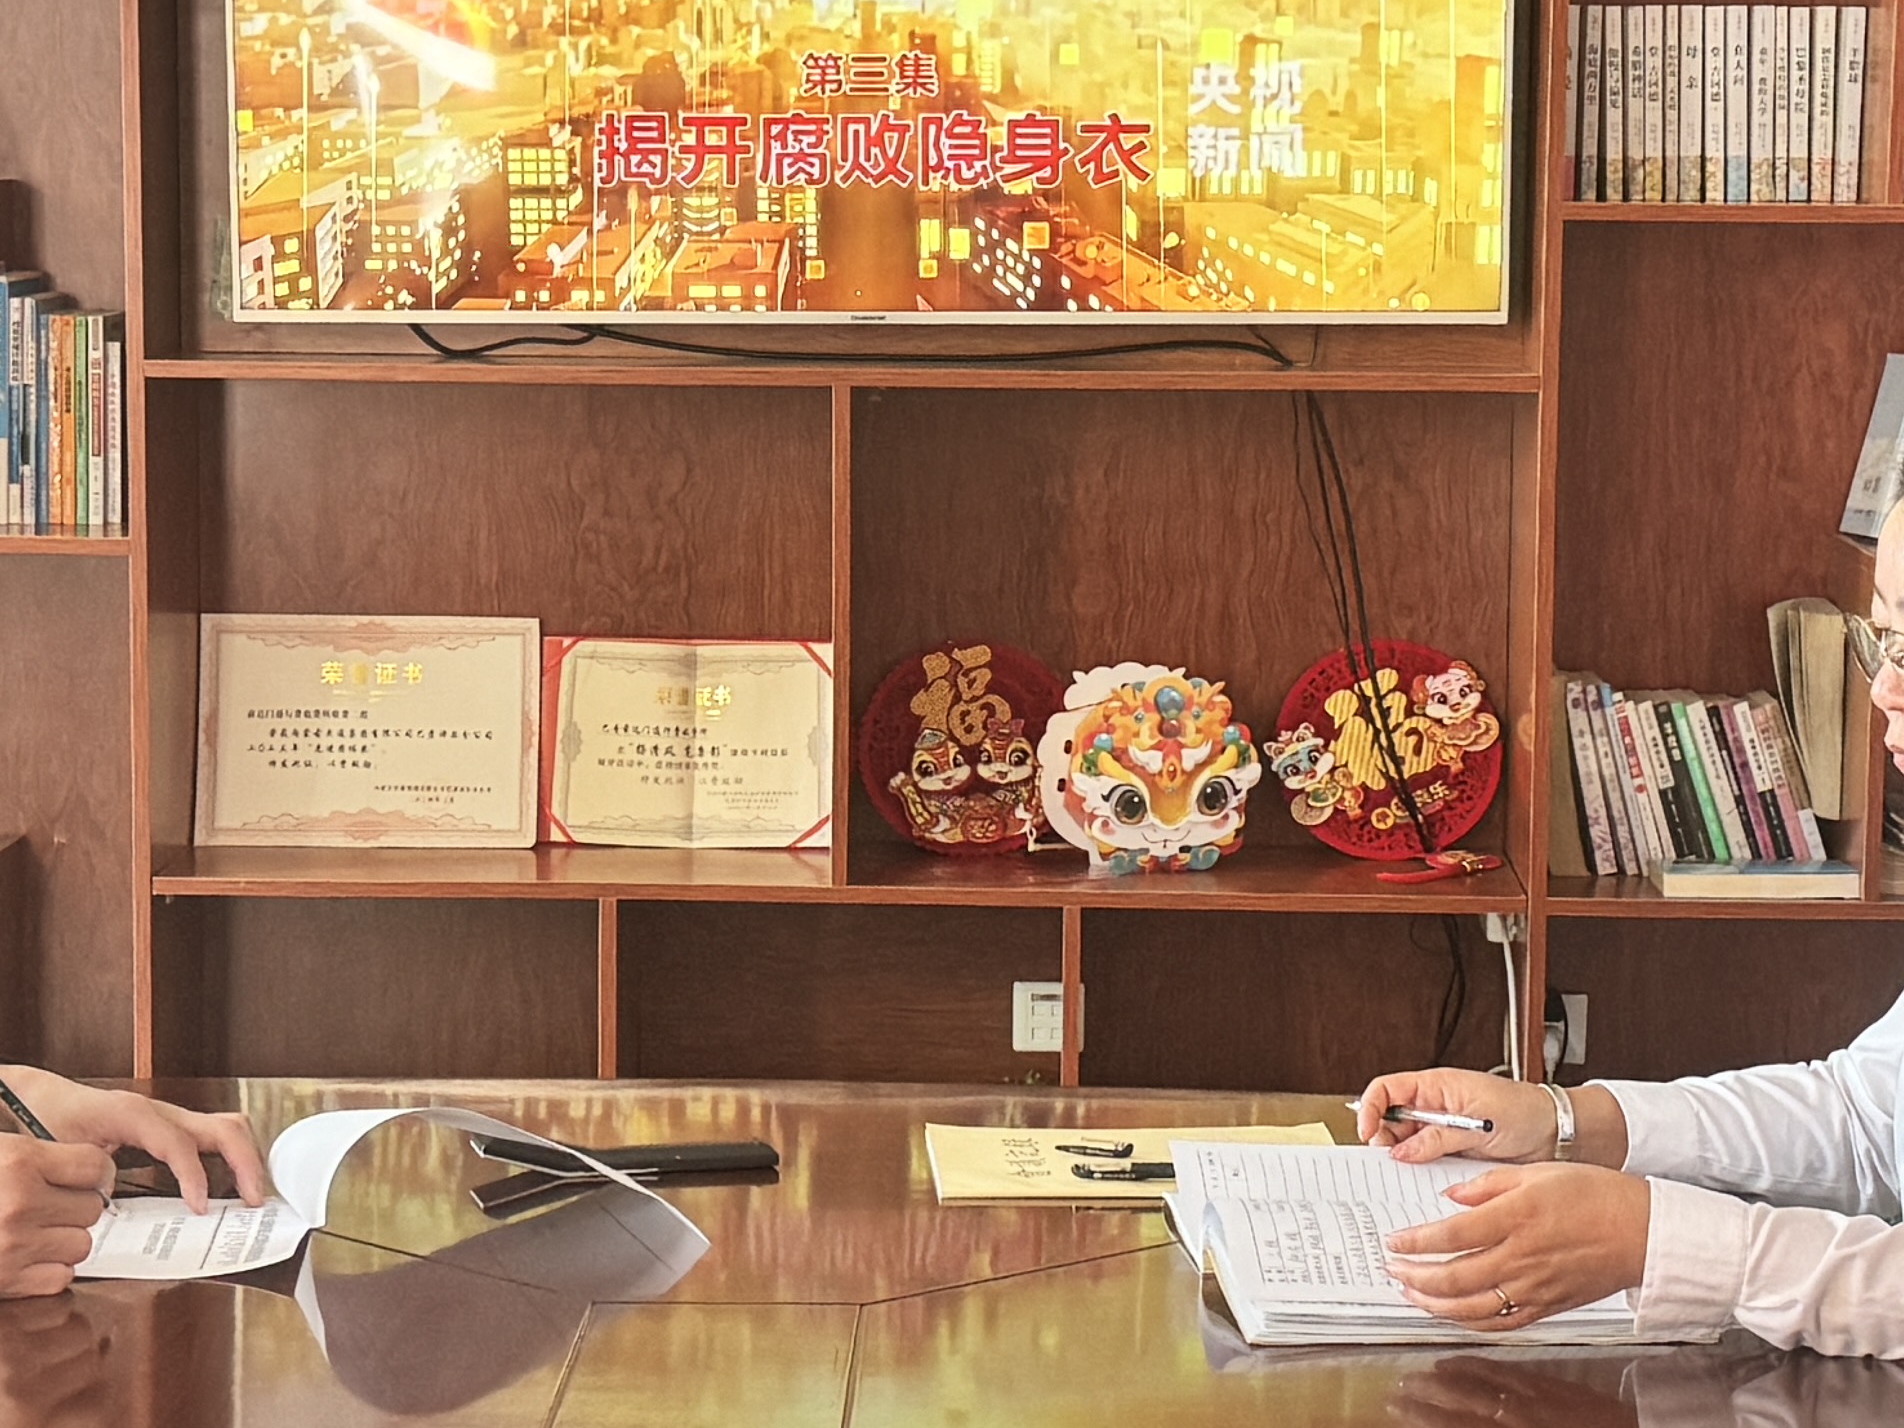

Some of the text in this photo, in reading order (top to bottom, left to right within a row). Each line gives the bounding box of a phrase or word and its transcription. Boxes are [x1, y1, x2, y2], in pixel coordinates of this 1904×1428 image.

[799, 51, 940, 100] 第三集
[592, 112, 1154, 190] 揭开腐败隐身衣
[911, 645, 1011, 745] 福
